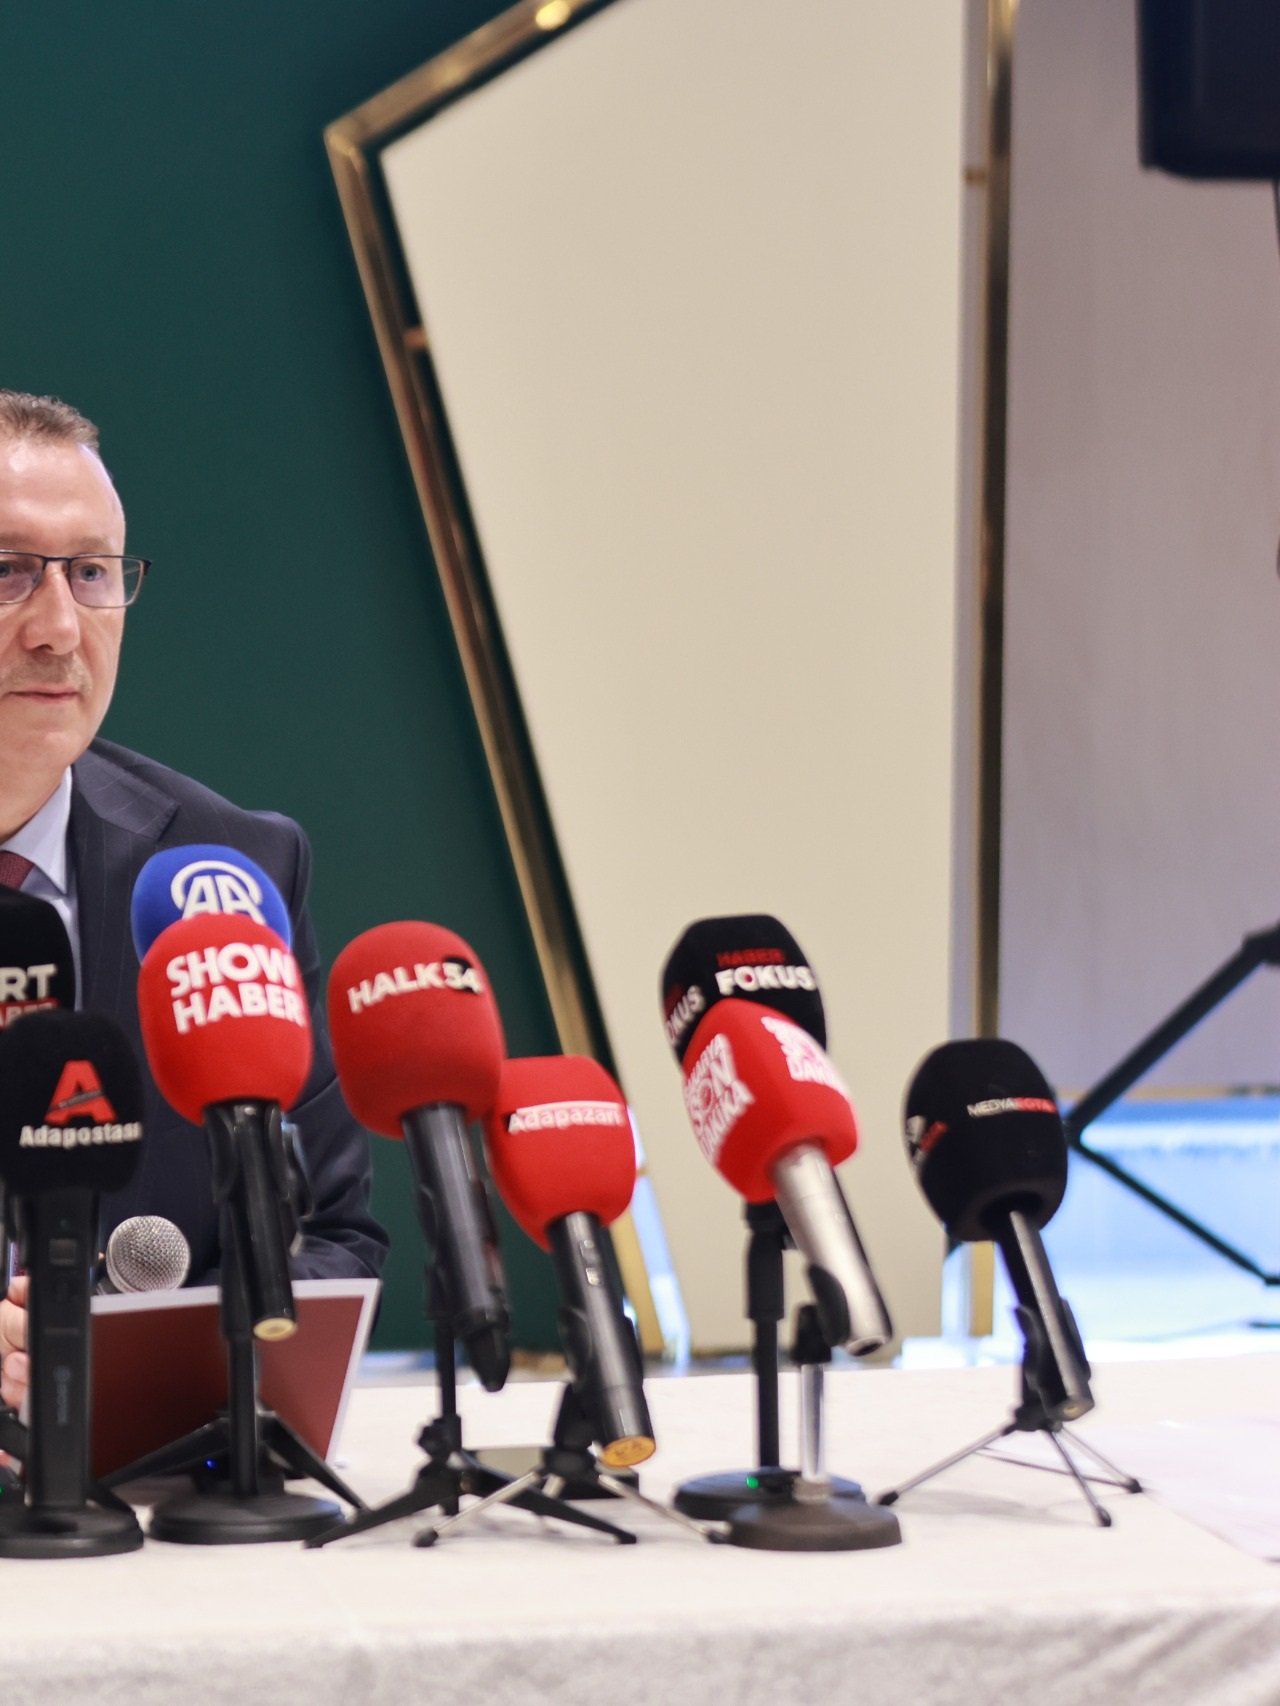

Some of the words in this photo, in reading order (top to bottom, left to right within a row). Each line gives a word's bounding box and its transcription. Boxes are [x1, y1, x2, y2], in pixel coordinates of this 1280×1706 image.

[182, 874, 267, 926] AA
[166, 942, 299, 998] SHOW
[715, 965, 817, 996] FOKUS
[172, 982, 307, 1035] HABER
